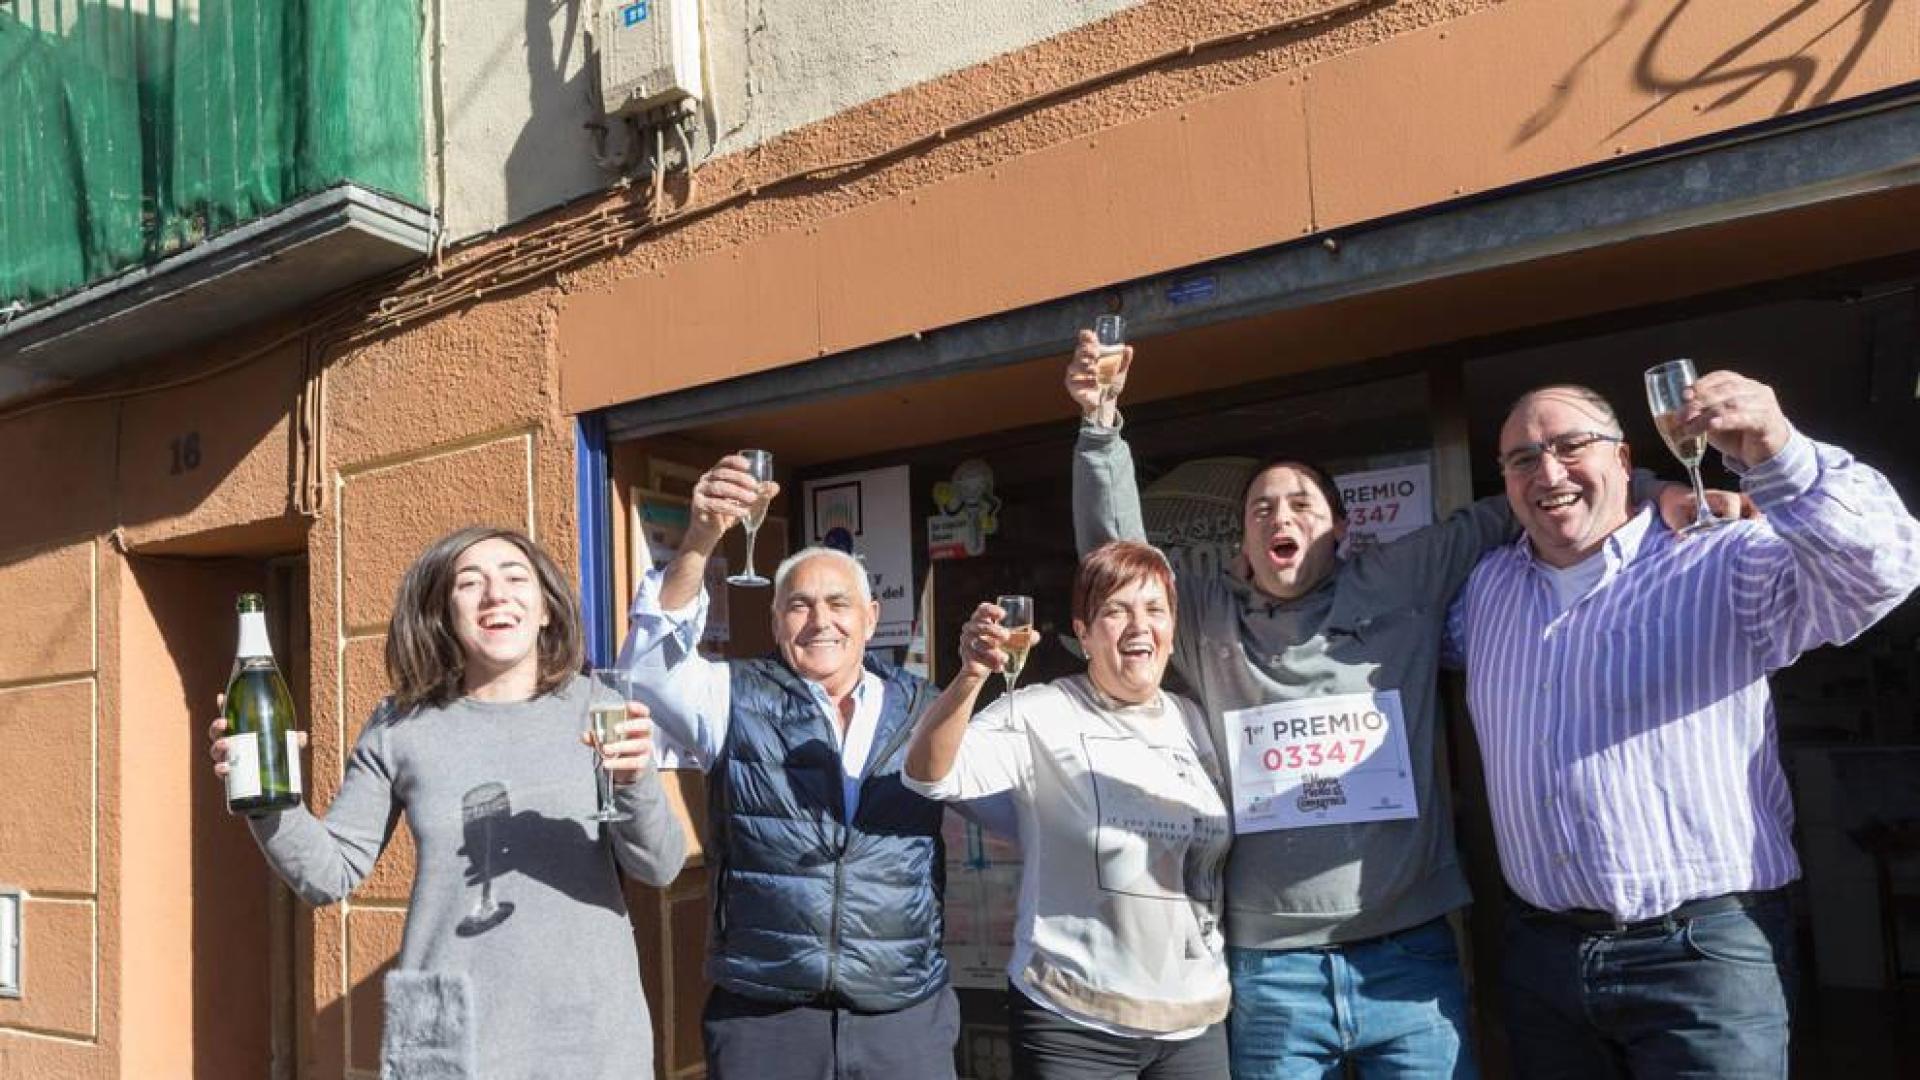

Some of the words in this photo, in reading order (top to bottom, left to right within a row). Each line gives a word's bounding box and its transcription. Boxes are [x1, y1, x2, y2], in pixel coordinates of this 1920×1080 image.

[168, 431, 202, 476] 16
[1340, 481, 1414, 502] REMIO
[1347, 504, 1399, 525] 347
[1273, 711, 1383, 740] PREMIO
[1264, 740, 1368, 770] 03347
